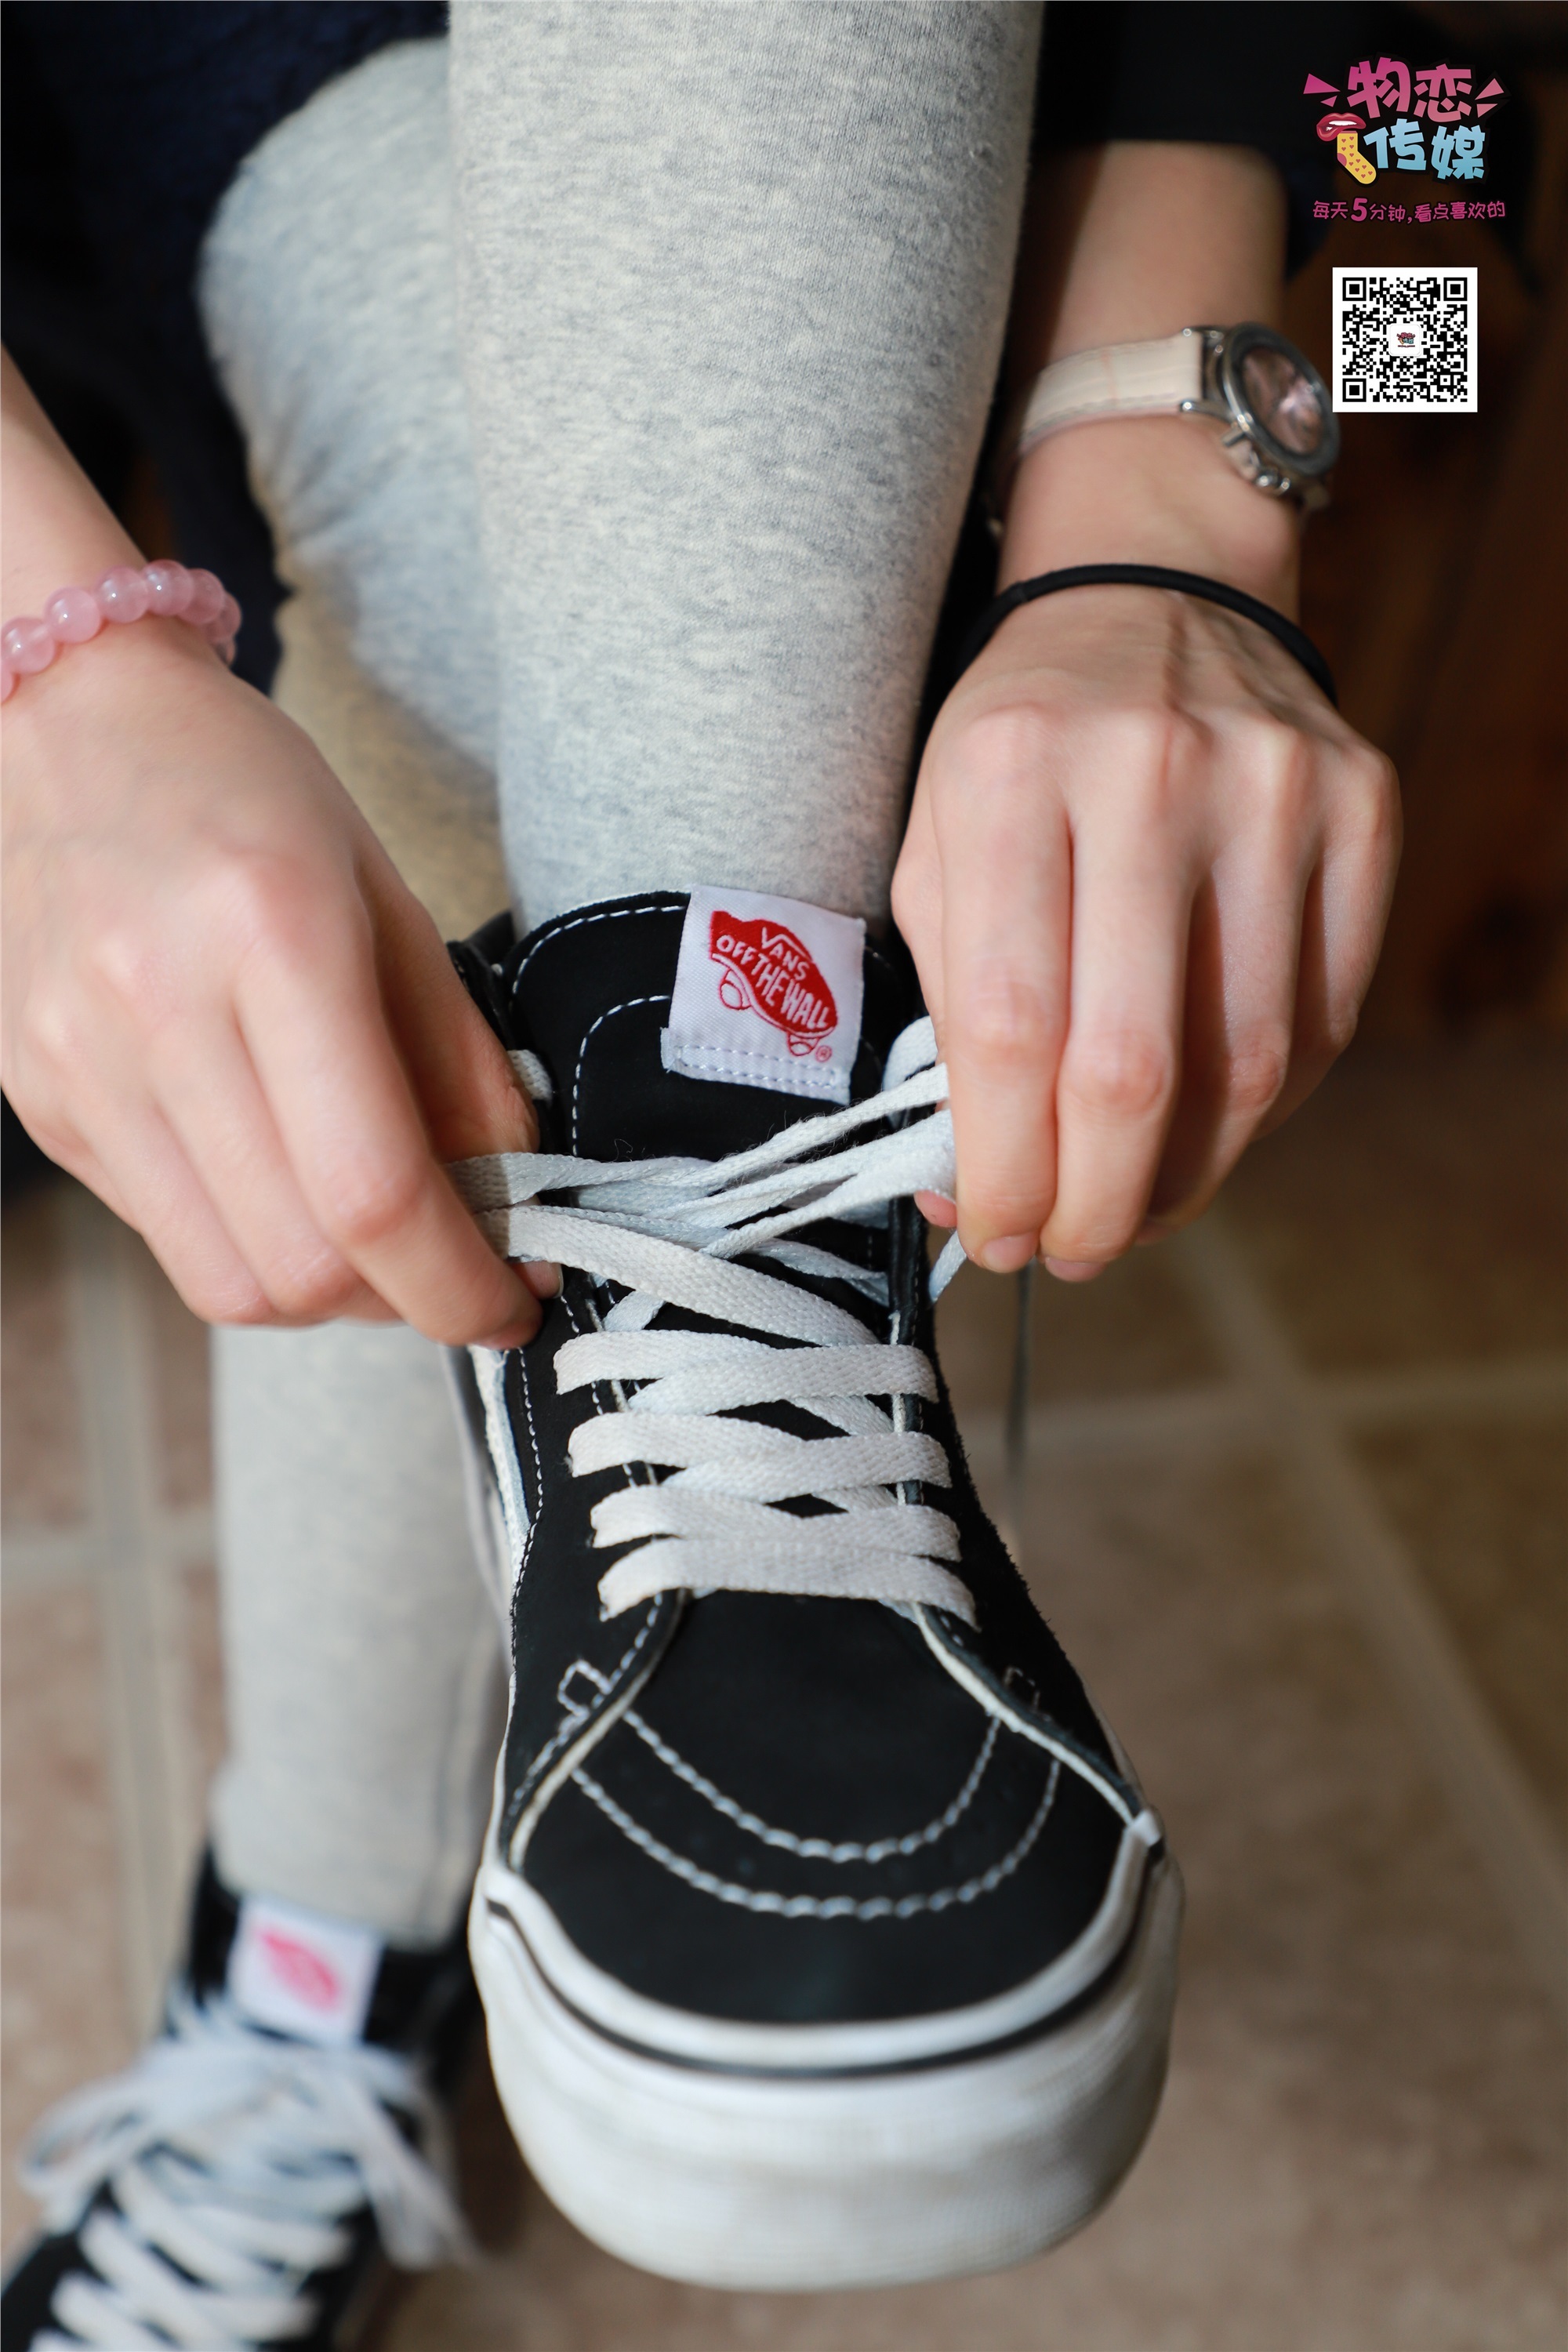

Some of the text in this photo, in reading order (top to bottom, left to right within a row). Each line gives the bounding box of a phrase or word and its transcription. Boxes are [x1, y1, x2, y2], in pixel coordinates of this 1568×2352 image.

[717, 935, 829, 1029] OFF THE WALL
[761, 927, 811, 980] VANS
